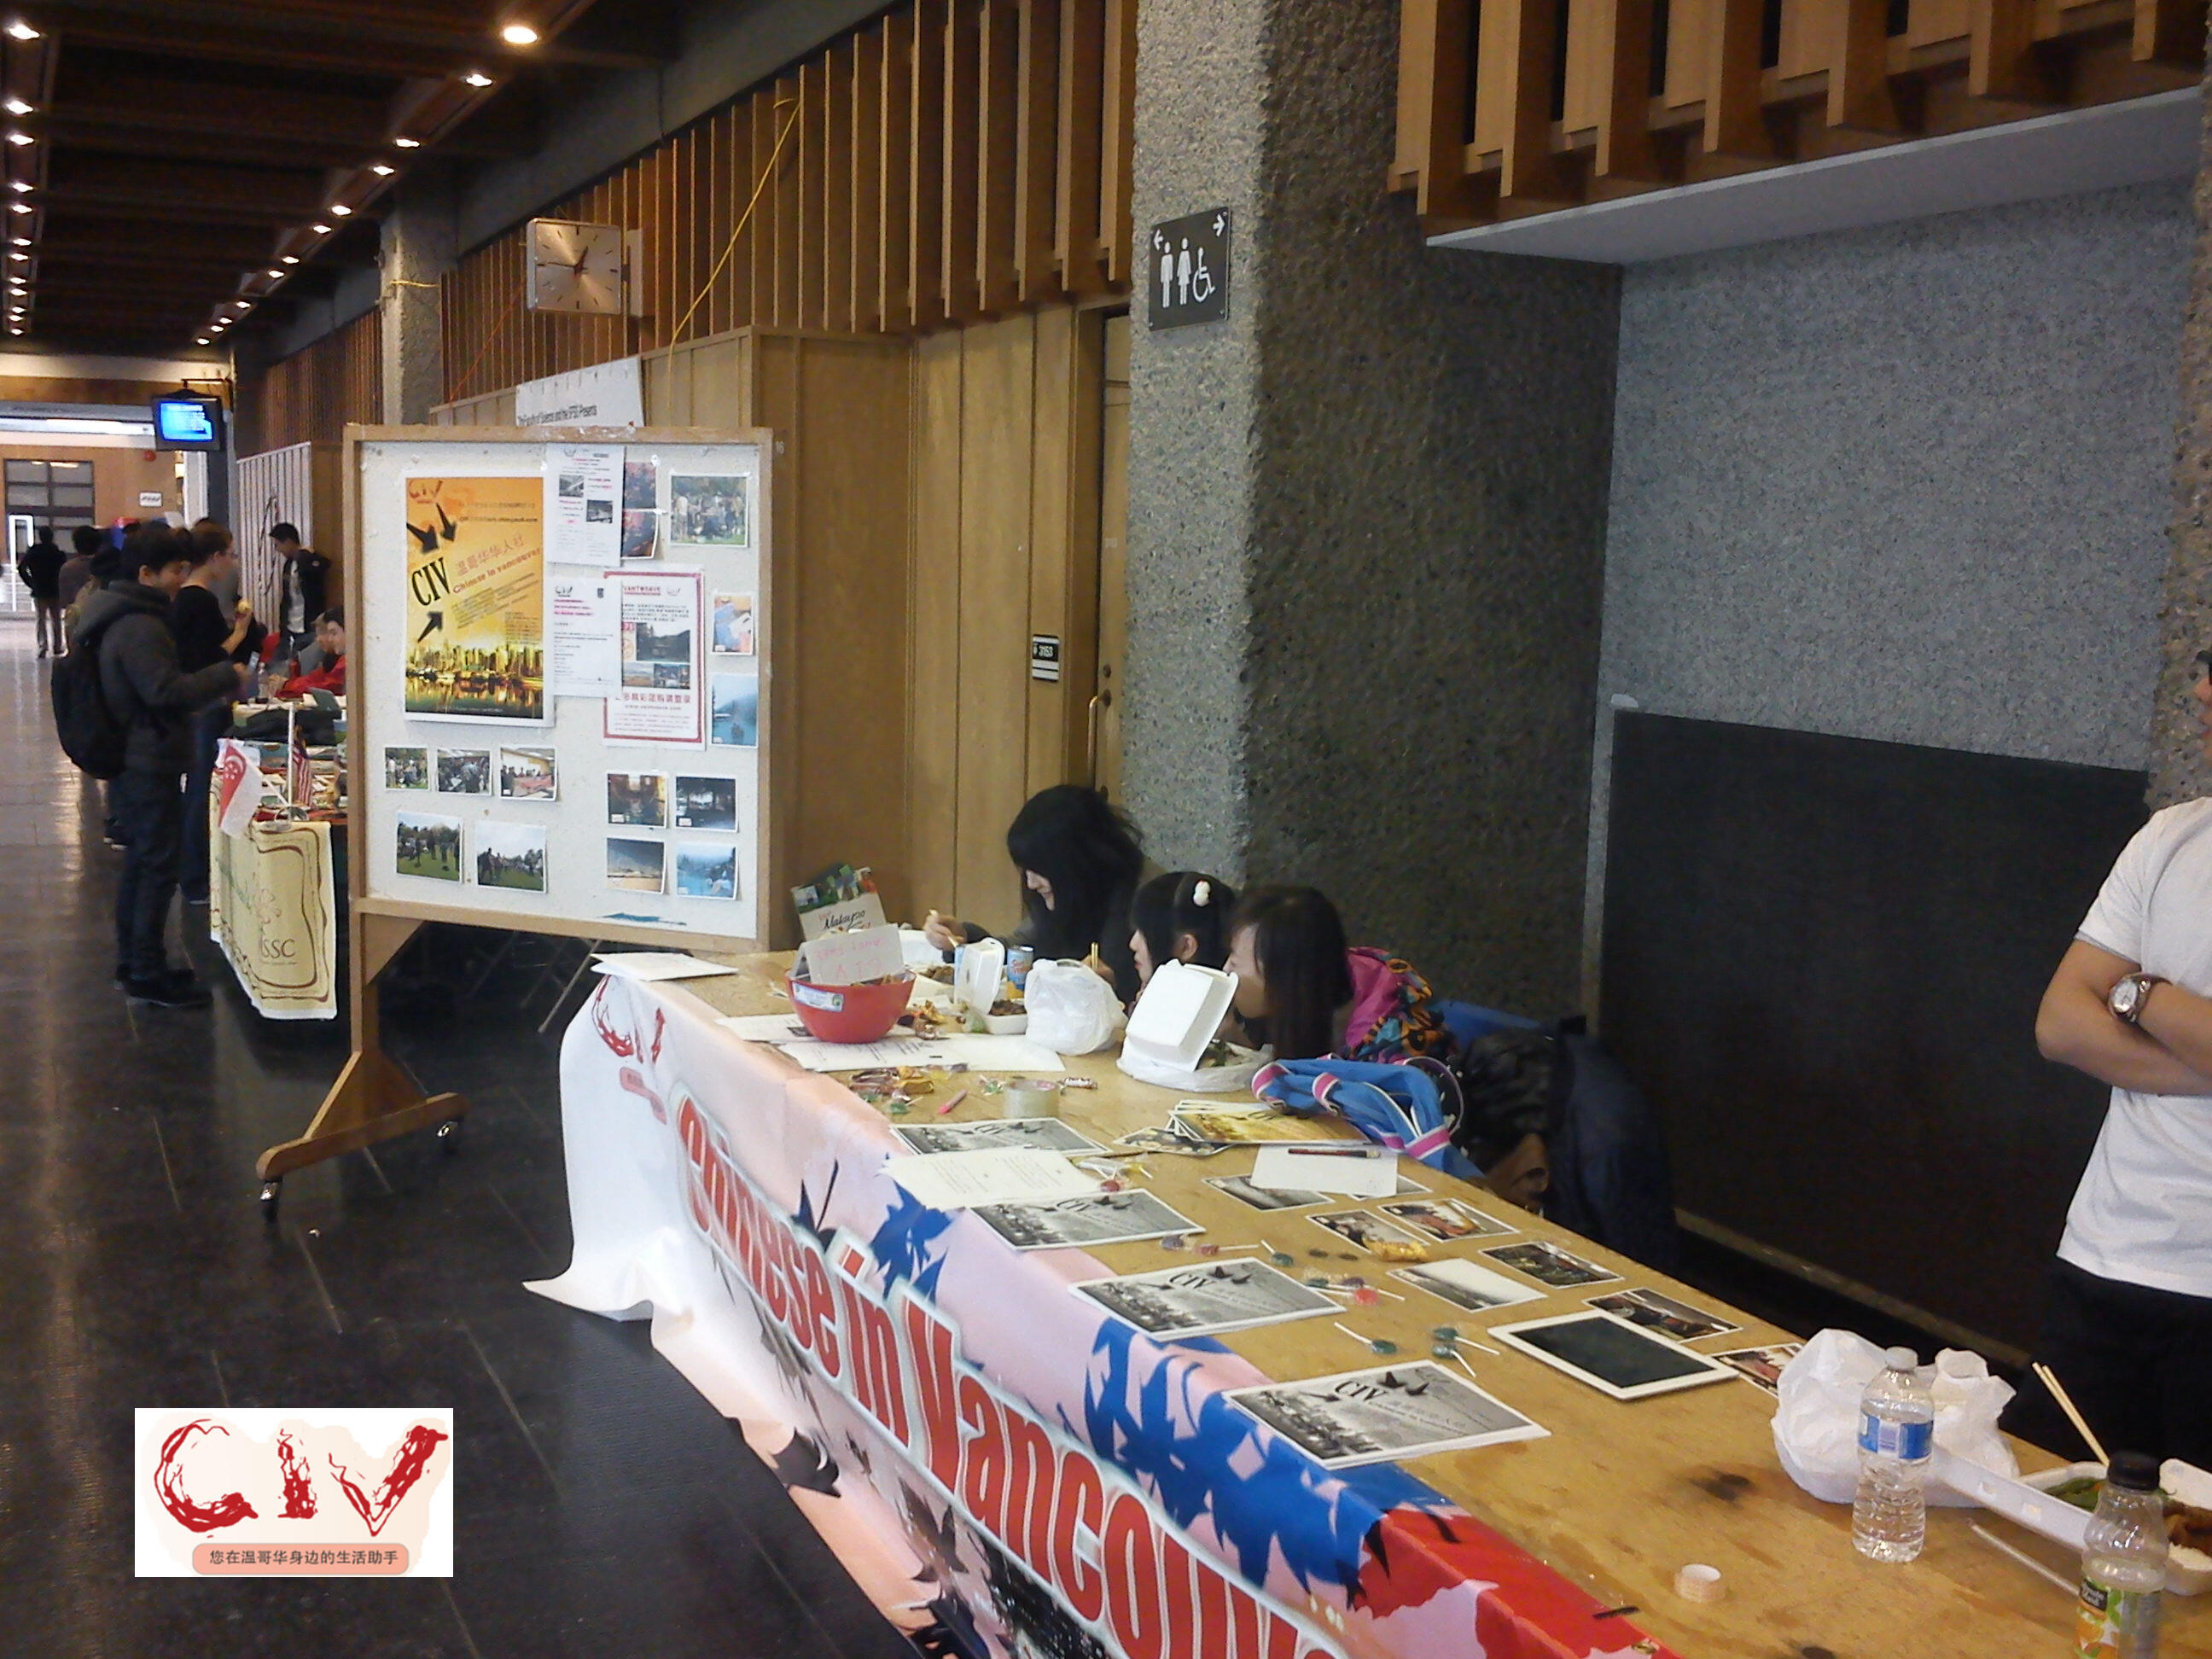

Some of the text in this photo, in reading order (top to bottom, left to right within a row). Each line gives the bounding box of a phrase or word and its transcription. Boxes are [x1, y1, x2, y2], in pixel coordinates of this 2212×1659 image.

[411, 557, 451, 607] CIV
[1057, 1197, 1097, 1213] CIV
[1169, 1272, 1217, 1289] CIV
[1335, 1381, 1388, 1401] CIV
[840, 1245, 911, 1447] in
[905, 1295, 1344, 1659] Vancou
